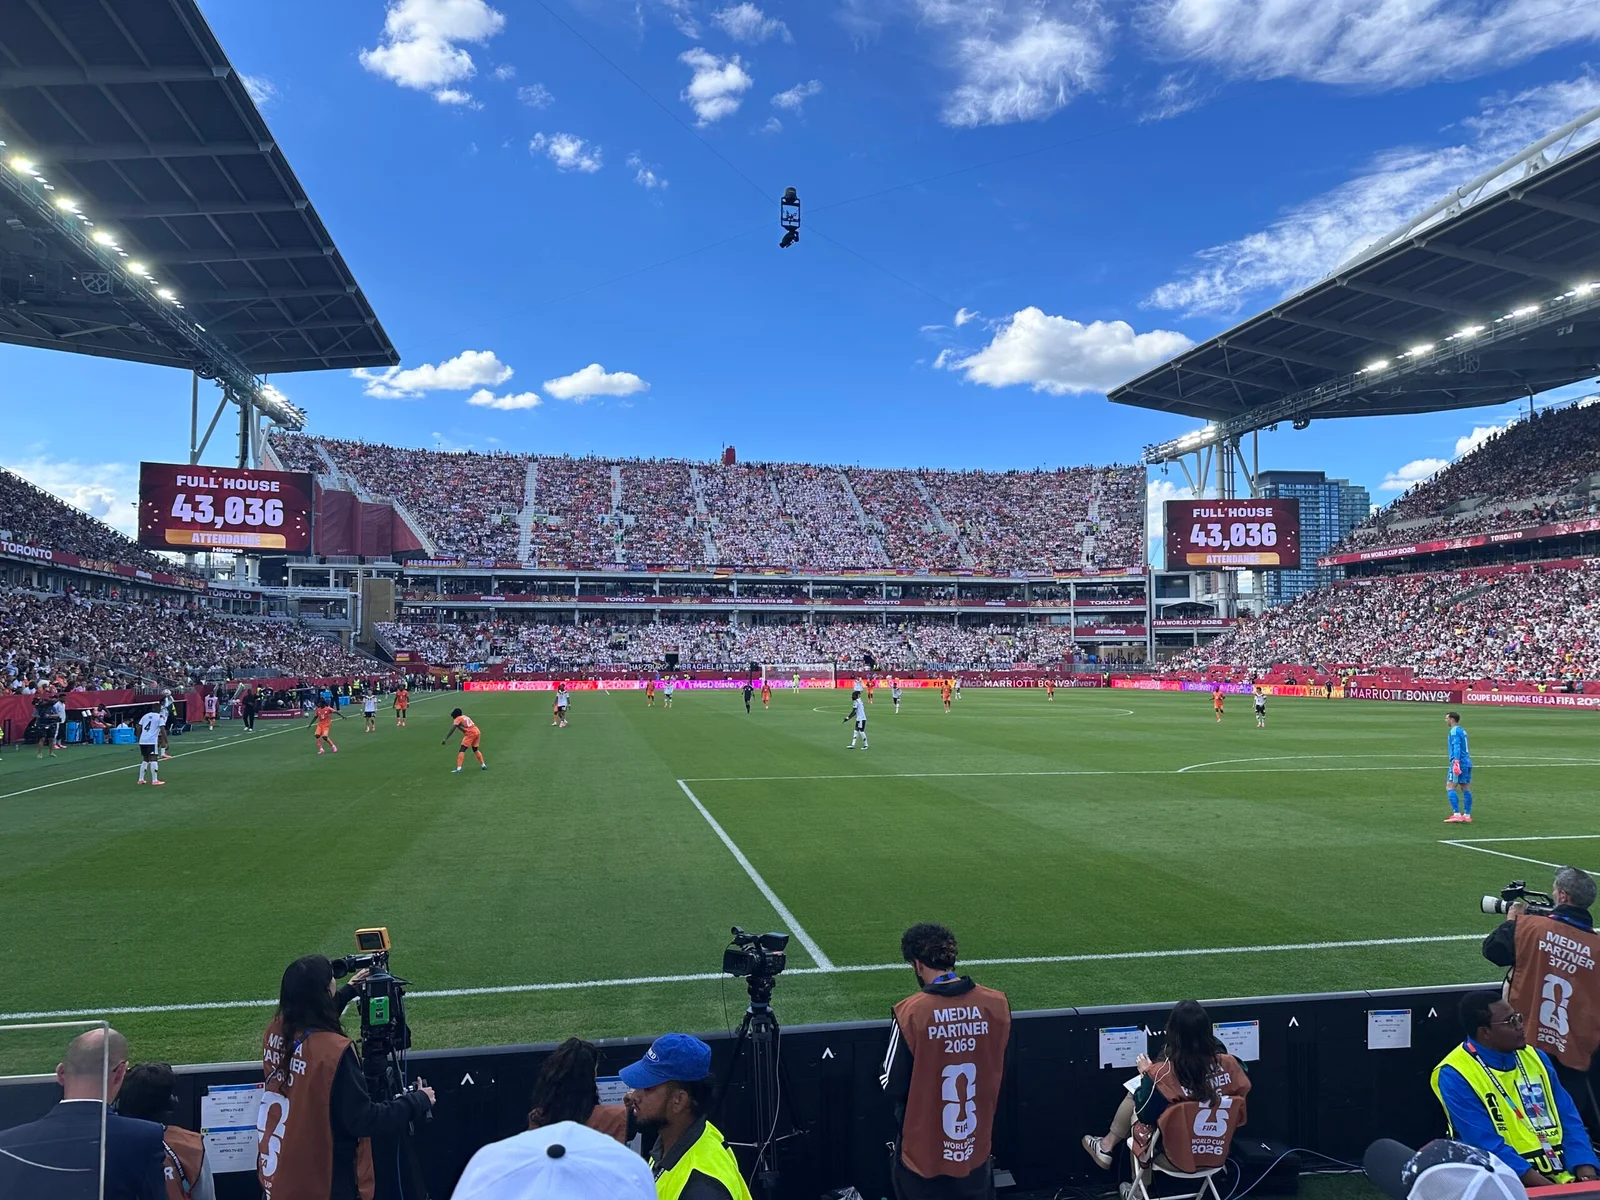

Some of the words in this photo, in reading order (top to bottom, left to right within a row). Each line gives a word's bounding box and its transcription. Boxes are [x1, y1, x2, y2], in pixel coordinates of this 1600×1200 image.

[176, 475, 219, 488] FULL
[223, 478, 280, 492] HOUSE
[171, 493, 284, 529] 43,036
[1193, 508, 1225, 518] FULL
[1228, 507, 1273, 517] HOUSE
[1190, 522, 1277, 551] 43,036
[1491, 532, 1523, 542] TORONTO
[0, 541, 53, 560] TORONTO
[212, 546, 243, 554] Hisense
[1371, 550, 1388, 558] WORLD
[208, 589, 252, 600] TORONTO
[984, 679, 1034, 688] MARRIOTT
[1350, 688, 1402, 700] MARRIOTT
[1406, 690, 1450, 703] BONVOY
[1467, 694, 1491, 702] COUPE
[1492, 694, 1502, 702] DU
[1503, 694, 1531, 704] MONDE
[1532, 695, 1543, 703] DE
[1544, 696, 1556, 704] LA
[1557, 697, 1575, 706] FIFA
[144, 720, 152, 732] 4
[1546, 930, 1591, 957] MEDIA
[1538, 940, 1596, 970] PARTNER
[1548, 955, 1577, 975] 3770
[933, 1005, 982, 1023] MEDIA
[928, 1021, 989, 1040] PARTNER
[267, 1033, 303, 1058] MEA
[944, 1037, 976, 1053] 2069
[1202, 1124, 1218, 1132] FIFA
[1191, 1145, 1223, 1156] 2026
